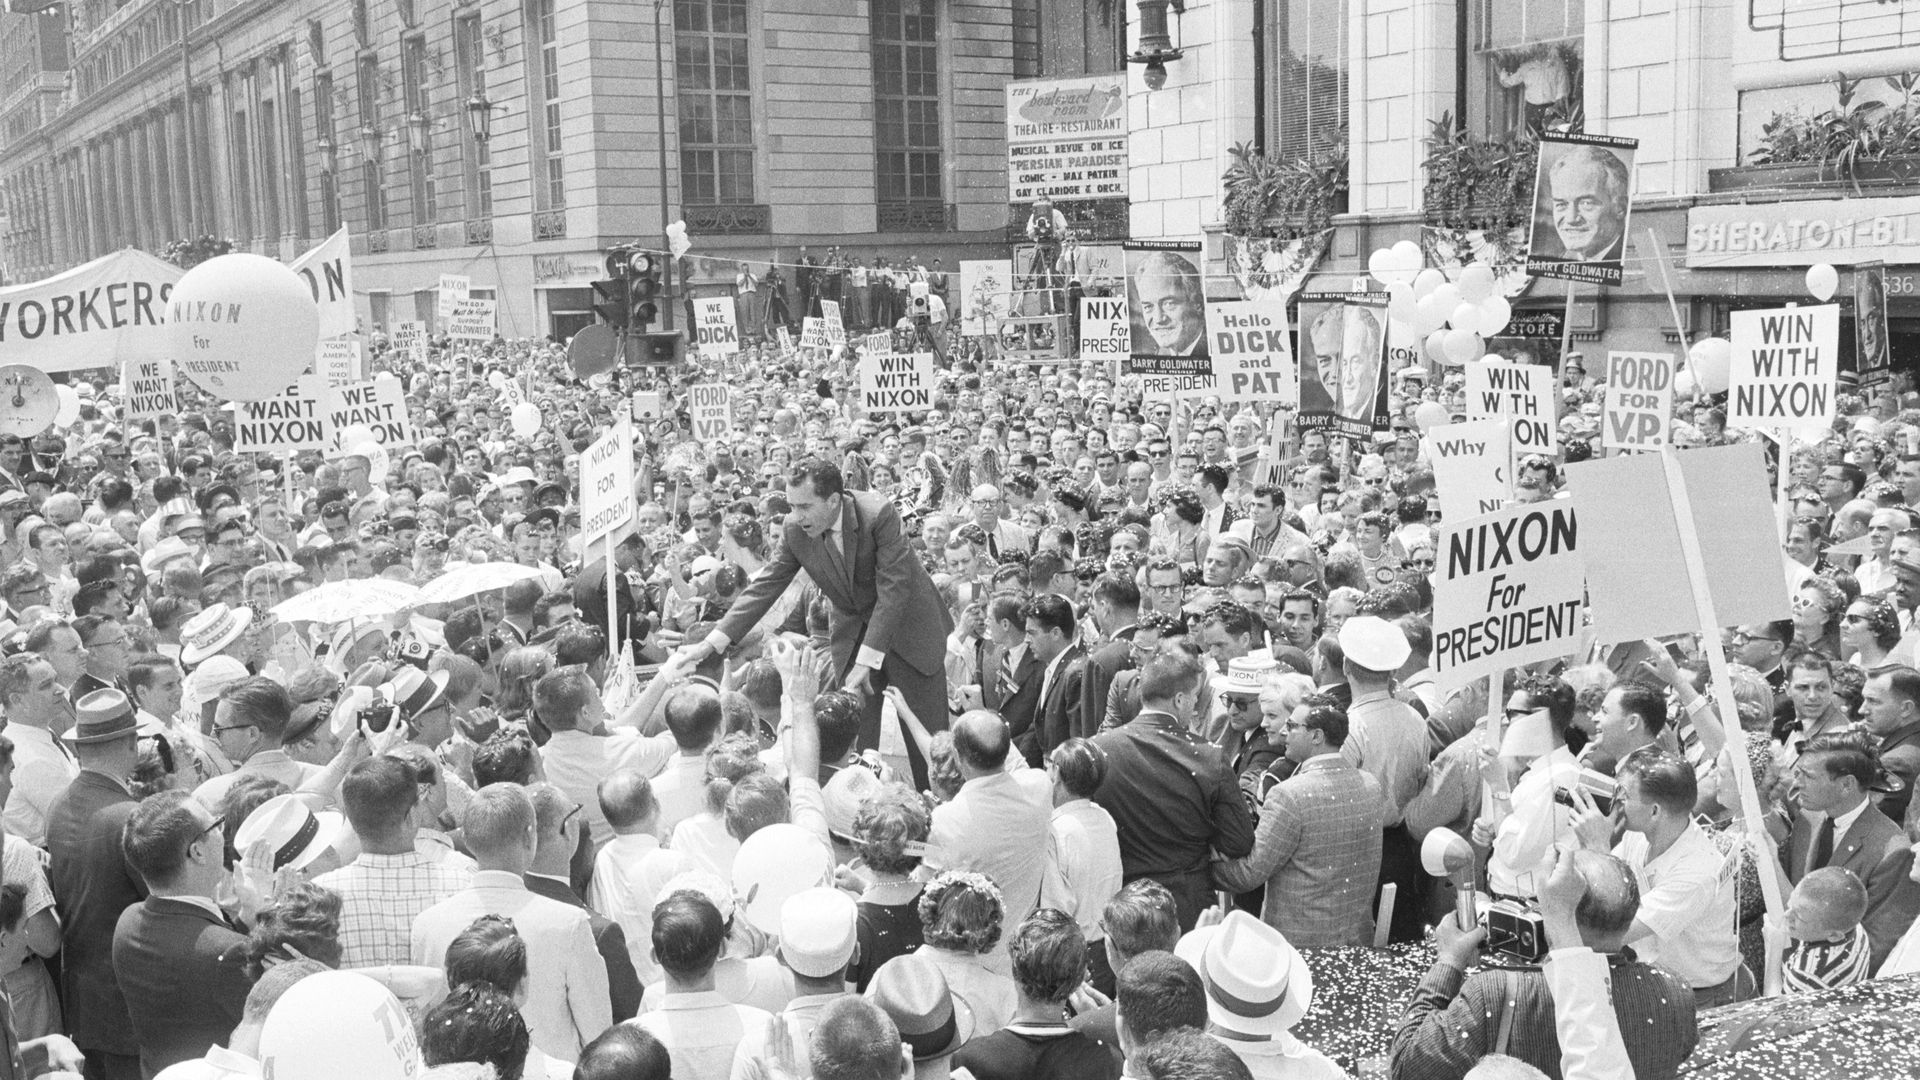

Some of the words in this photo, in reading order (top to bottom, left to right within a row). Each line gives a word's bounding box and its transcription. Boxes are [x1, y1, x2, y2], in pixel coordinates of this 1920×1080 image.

[1011, 87, 1032, 97] THE
[1029, 84, 1095, 108] boulevard
[1053, 105, 1089, 116] room
[1011, 145, 1049, 157] MUSICAL
[1054, 143, 1084, 154] REVUE
[1090, 142, 1103, 152] ON
[1108, 140, 1124, 150] ICE
[1613, 137, 1636, 146] CHOICE
[1019, 173, 1046, 184] COMIC
[1063, 171, 1083, 181] MAX
[1087, 169, 1118, 180] PATKIN
[1015, 188, 1032, 198] GAY
[1036, 185, 1080, 196] CLARIDGE
[1085, 184, 1092, 194] &
[1096, 183, 1124, 194] ORCH.
[1528, 259, 1560, 273] BARRY
[1562, 262, 1622, 280] GOLDWATER
[442, 279, 468, 291] NIXON
[173, 301, 242, 324] NIXON
[706, 303, 723, 314] WE
[1086, 301, 1128, 320] NIX
[704, 314, 726, 325] LIKE
[812, 320, 826, 329] WE
[1223, 314, 1271, 328] Hello
[395, 330, 421, 339] WANT
[450, 324, 492, 336] GOLDWATER
[698, 325, 737, 345] DICK
[807, 328, 828, 338] WAN
[1510, 323, 1556, 335] STORE
[1760, 314, 1814, 345] WIN
[193, 335, 210, 349] For
[803, 336, 830, 347] NIXON
[868, 334, 890, 351] FORD
[1081, 338, 1130, 354] PRESID
[1216, 330, 1285, 354] DICK
[139, 362, 159, 377] WE
[185, 360, 240, 374] PRESIDENT
[879, 357, 915, 373] WIN
[1132, 357, 1157, 369] BARRY
[1160, 359, 1211, 370] GOLDWATER
[1239, 356, 1272, 369] and
[1752, 346, 1819, 378] WITH
[875, 372, 920, 389] WITH
[1487, 367, 1530, 392] WIN
[1609, 356, 1670, 391] FORD
[132, 378, 168, 395] WANT
[1231, 372, 1282, 395] PAT
[130, 392, 174, 413] NIXON
[342, 386, 377, 406] WE
[693, 384, 728, 407] FORD
[866, 388, 930, 408] NIXON
[1482, 391, 1538, 416] WTH
[1619, 393, 1660, 409] FOR
[1736, 382, 1827, 417] NIXON
[250, 399, 316, 419] WANT
[330, 403, 394, 428] WANT
[701, 408, 726, 418] FOR
[1300, 415, 1329, 426] BARRY
[1608, 411, 1662, 445] V.P.
[240, 420, 323, 446] NIXON
[697, 419, 730, 440] V.P.
[591, 433, 620, 468] NIXON
[1436, 439, 1486, 457] Why
[597, 472, 615, 497] FOR
[586, 495, 629, 537] PRESIDENT
[1448, 506, 1578, 581] NIXON
[1487, 573, 1527, 613] For
[1436, 600, 1581, 673] PRESIDENT
